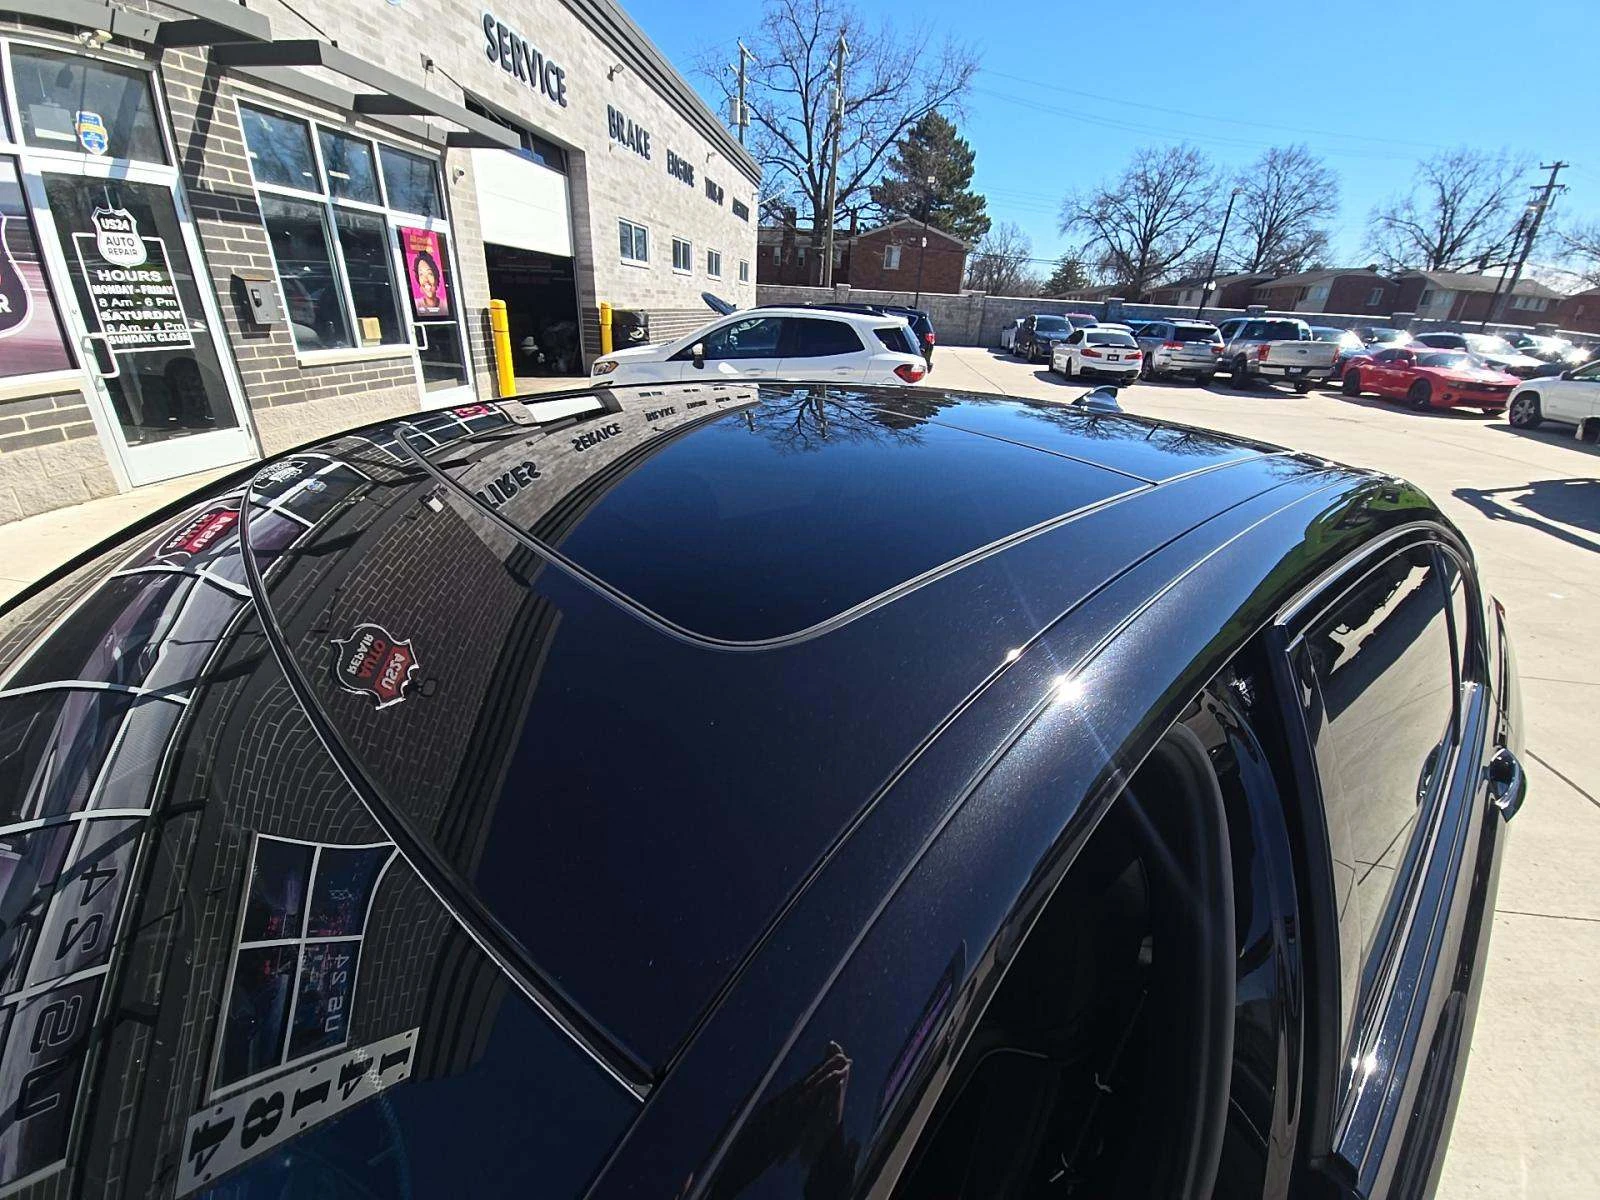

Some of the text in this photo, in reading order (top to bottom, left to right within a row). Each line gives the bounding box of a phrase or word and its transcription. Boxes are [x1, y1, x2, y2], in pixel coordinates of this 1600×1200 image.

[483, 13, 568, 108] SERVICE
[607, 103, 650, 161] BRAKE
[666, 148, 695, 188] ENGINE
[100, 217, 130, 231] US24
[106, 236, 135, 247] AUTO
[108, 247, 138, 256] REPAIR
[97, 269, 163, 282] HOURS
[92, 284, 134, 294] MONDAY
[140, 284, 174, 294] FRIDAY
[99, 298, 108, 308] 8
[111, 298, 134, 307] Am
[144, 298, 154, 307] 6
[155, 298, 178, 307] Pm
[100, 309, 181, 321] SATURDAY
[119, 323, 141, 332] Am
[152, 322, 161, 332] 4
[163, 322, 185, 332] Pm
[107, 333, 156, 345] SUNDAY:
